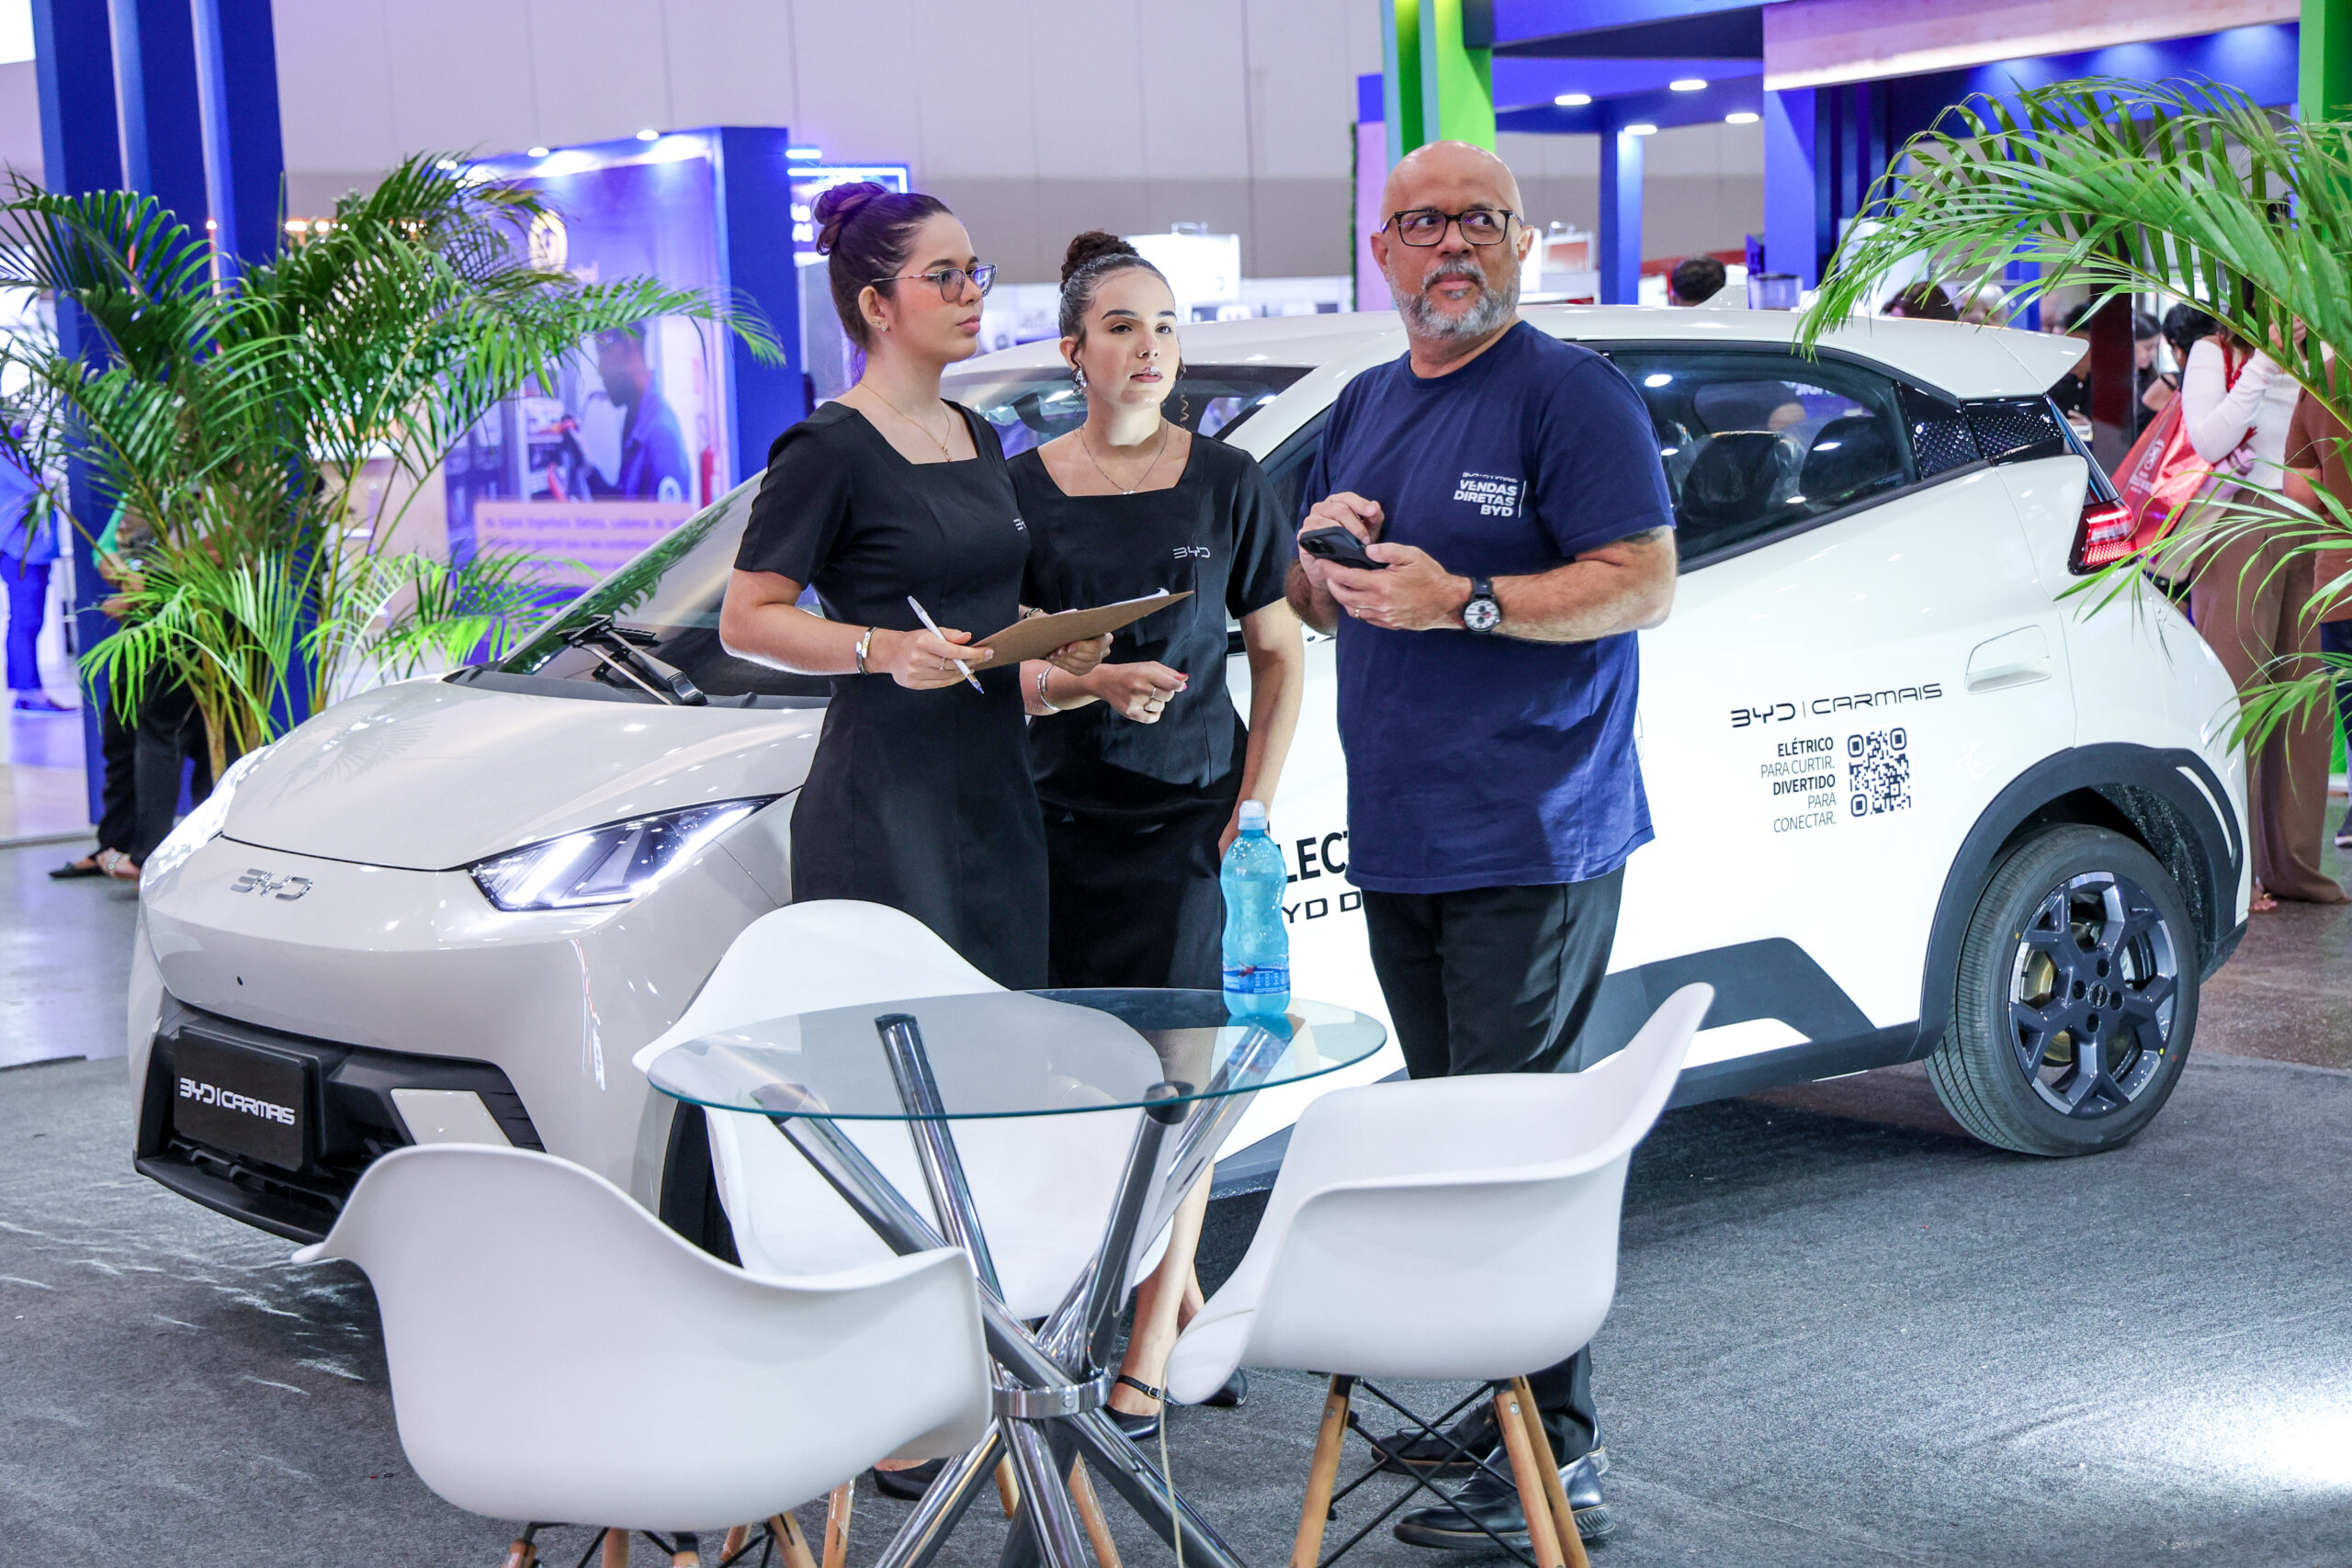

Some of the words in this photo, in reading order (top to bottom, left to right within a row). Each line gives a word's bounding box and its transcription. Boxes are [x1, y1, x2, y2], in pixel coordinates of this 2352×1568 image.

[1453, 490, 1515, 506] DIRETAS
[1460, 479, 1518, 496] VENDAS
[1480, 504, 1513, 517] BYD
[1172, 546, 1211, 559] BYD
[1731, 703, 1796, 728] BYD
[1812, 683, 1943, 715] CARMAIS
[1778, 737, 1834, 757] ELÉTRICO
[1760, 761, 1790, 779] PARA
[1792, 755, 1835, 774] CURTIR.
[1773, 773, 1836, 795] DIVERTIDO
[1807, 792, 1837, 809] PARA
[1773, 811, 1837, 833] CONECTAR.
[1276, 830, 1348, 884] EC
[231, 868, 313, 901] BYD
[179, 1077, 216, 1104] BYD
[220, 1090, 296, 1125] CARMAIS
